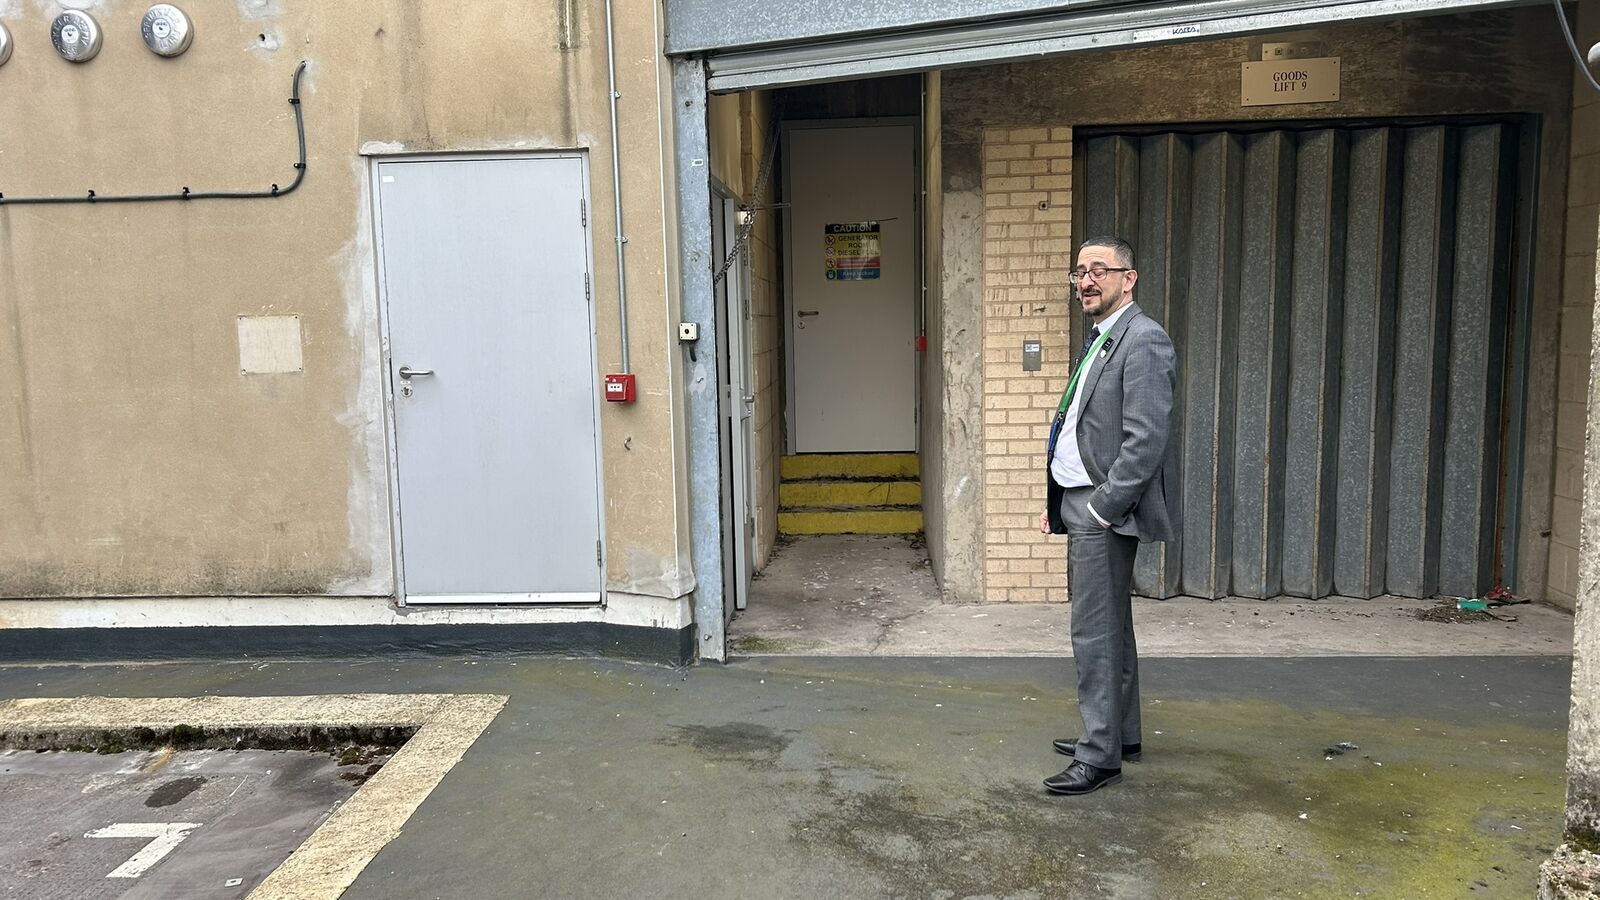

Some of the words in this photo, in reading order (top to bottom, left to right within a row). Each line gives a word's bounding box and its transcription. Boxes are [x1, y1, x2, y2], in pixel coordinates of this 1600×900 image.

[1273, 71, 1308, 81] GOODS
[1274, 82, 1296, 92] LIFT
[1301, 81, 1307, 90] 9
[833, 224, 872, 232] CAUTION
